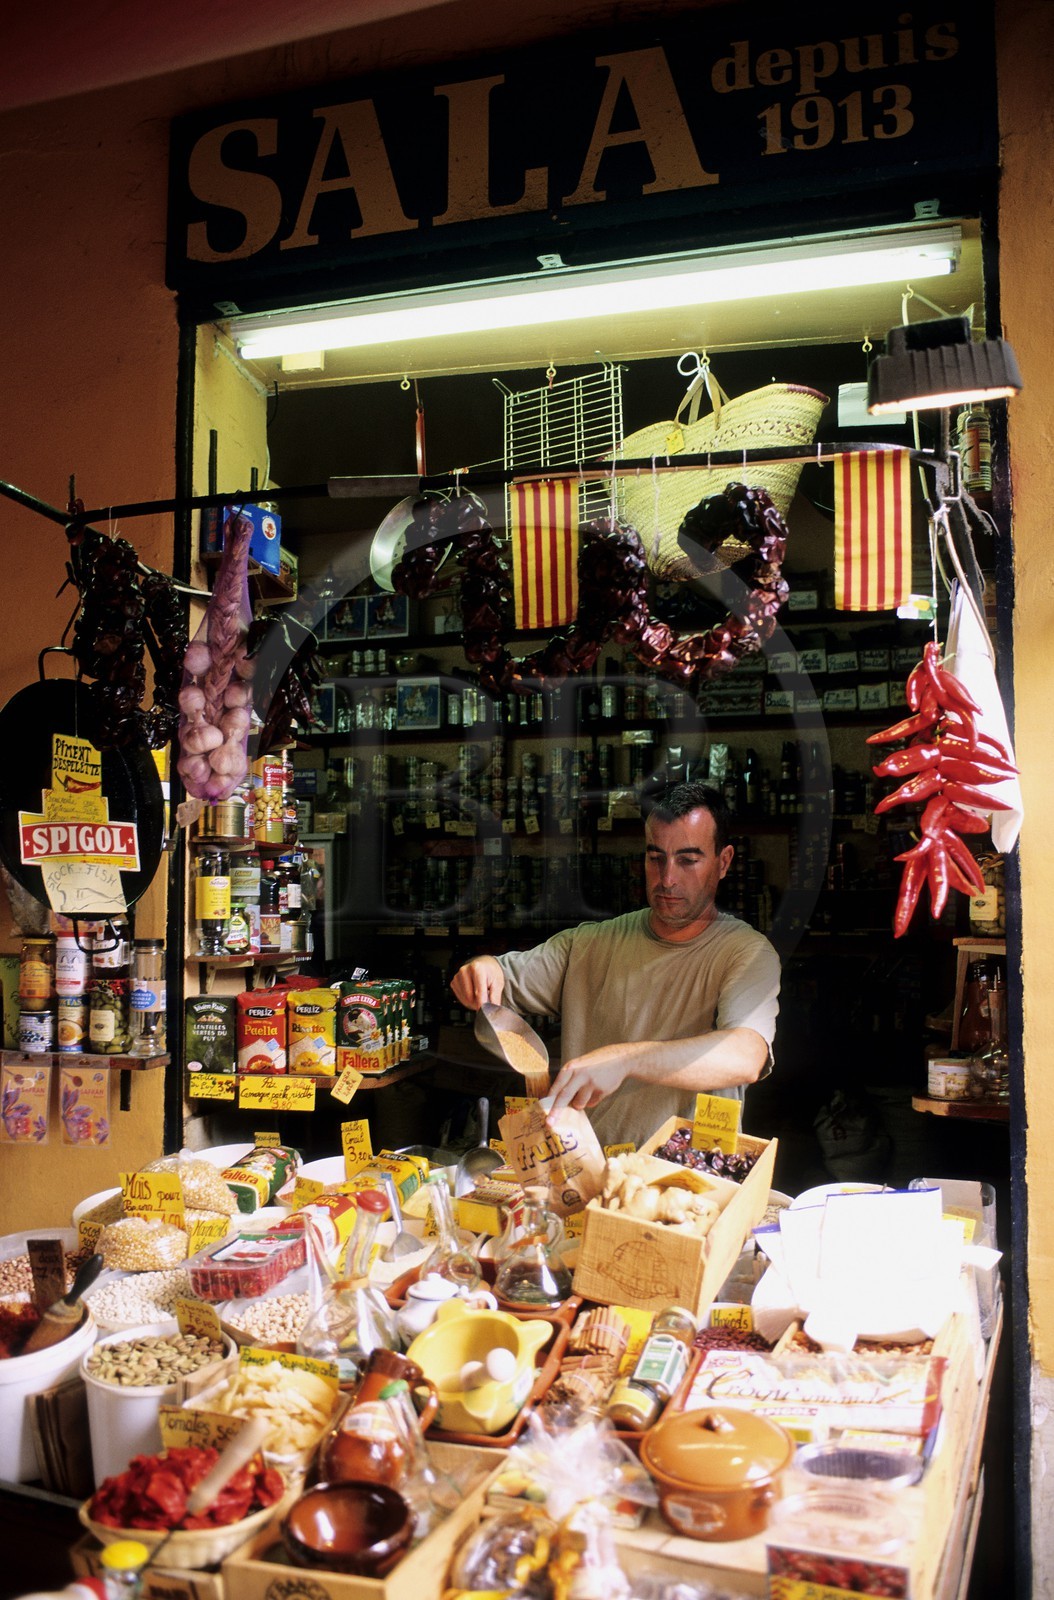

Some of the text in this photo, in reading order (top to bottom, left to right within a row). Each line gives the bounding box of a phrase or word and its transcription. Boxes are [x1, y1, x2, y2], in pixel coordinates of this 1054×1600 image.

[711, 12, 960, 95] depuis
[756, 84, 916, 157] 1913
[185, 46, 720, 263] SALA
[32, 825, 128, 856] SPIGOL
[46, 863, 119, 892] STOCK FISH
[244, 1024, 278, 1036] Paella
[291, 1023, 326, 1034] Risotto
[341, 1051, 380, 1069] Fallera
[517, 1132, 579, 1171] fruits
[121, 1173, 181, 1208] Maïs pour
[220, 1169, 259, 1186] Fallera
[713, 1308, 749, 1330] Haricots
[159, 1409, 210, 1437] Tomates
